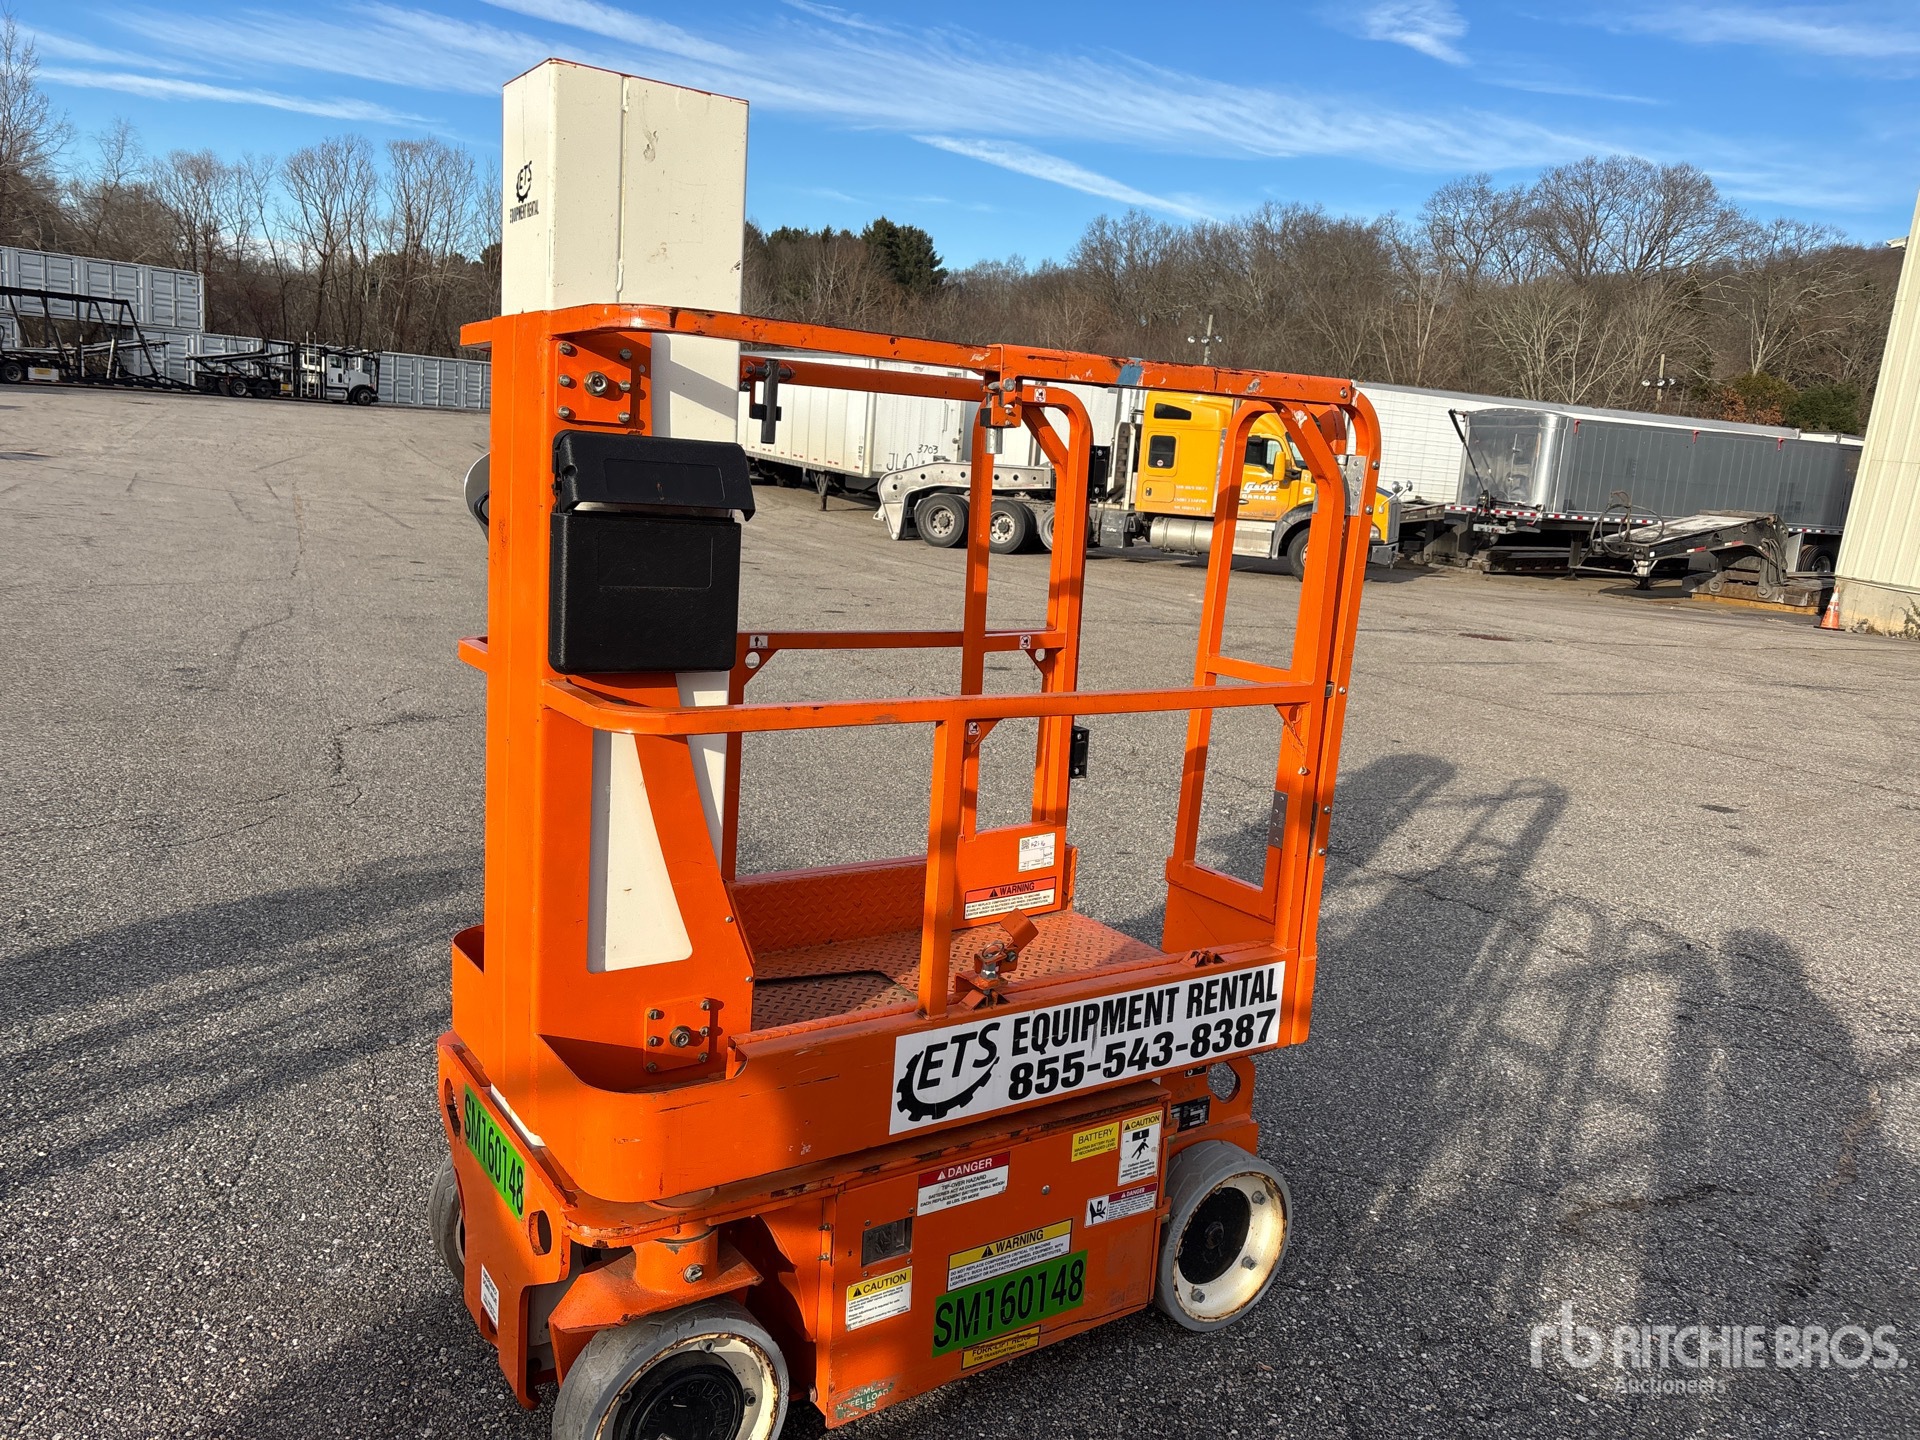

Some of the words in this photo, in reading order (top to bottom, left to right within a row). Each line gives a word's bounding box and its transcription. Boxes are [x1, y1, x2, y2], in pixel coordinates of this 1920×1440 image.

[518, 160, 532, 190] ETS
[917, 444, 939, 455] 3703
[1241, 493, 1277, 501] GARAGE
[1302, 486, 1312, 496] 6
[1000, 882, 1035, 896] WARNING
[1011, 986, 1180, 1057] EQUIPMENT
[1186, 967, 1278, 1020] RENTAL
[917, 1022, 1000, 1090] ETS
[1008, 1008, 1277, 1101] 855-543-8387
[1130, 1115, 1160, 1129] CAUTION
[1078, 1128, 1114, 1144] BATTERY
[464, 1093, 524, 1216] SM160148
[947, 1157, 993, 1178] DANGER
[966, 1174, 987, 1184] HAZARD
[1126, 1187, 1145, 1198] DANGER
[995, 1229, 1044, 1254] WARNING
[862, 1272, 907, 1294] CAUTION
[933, 1258, 1085, 1348] SM160148
